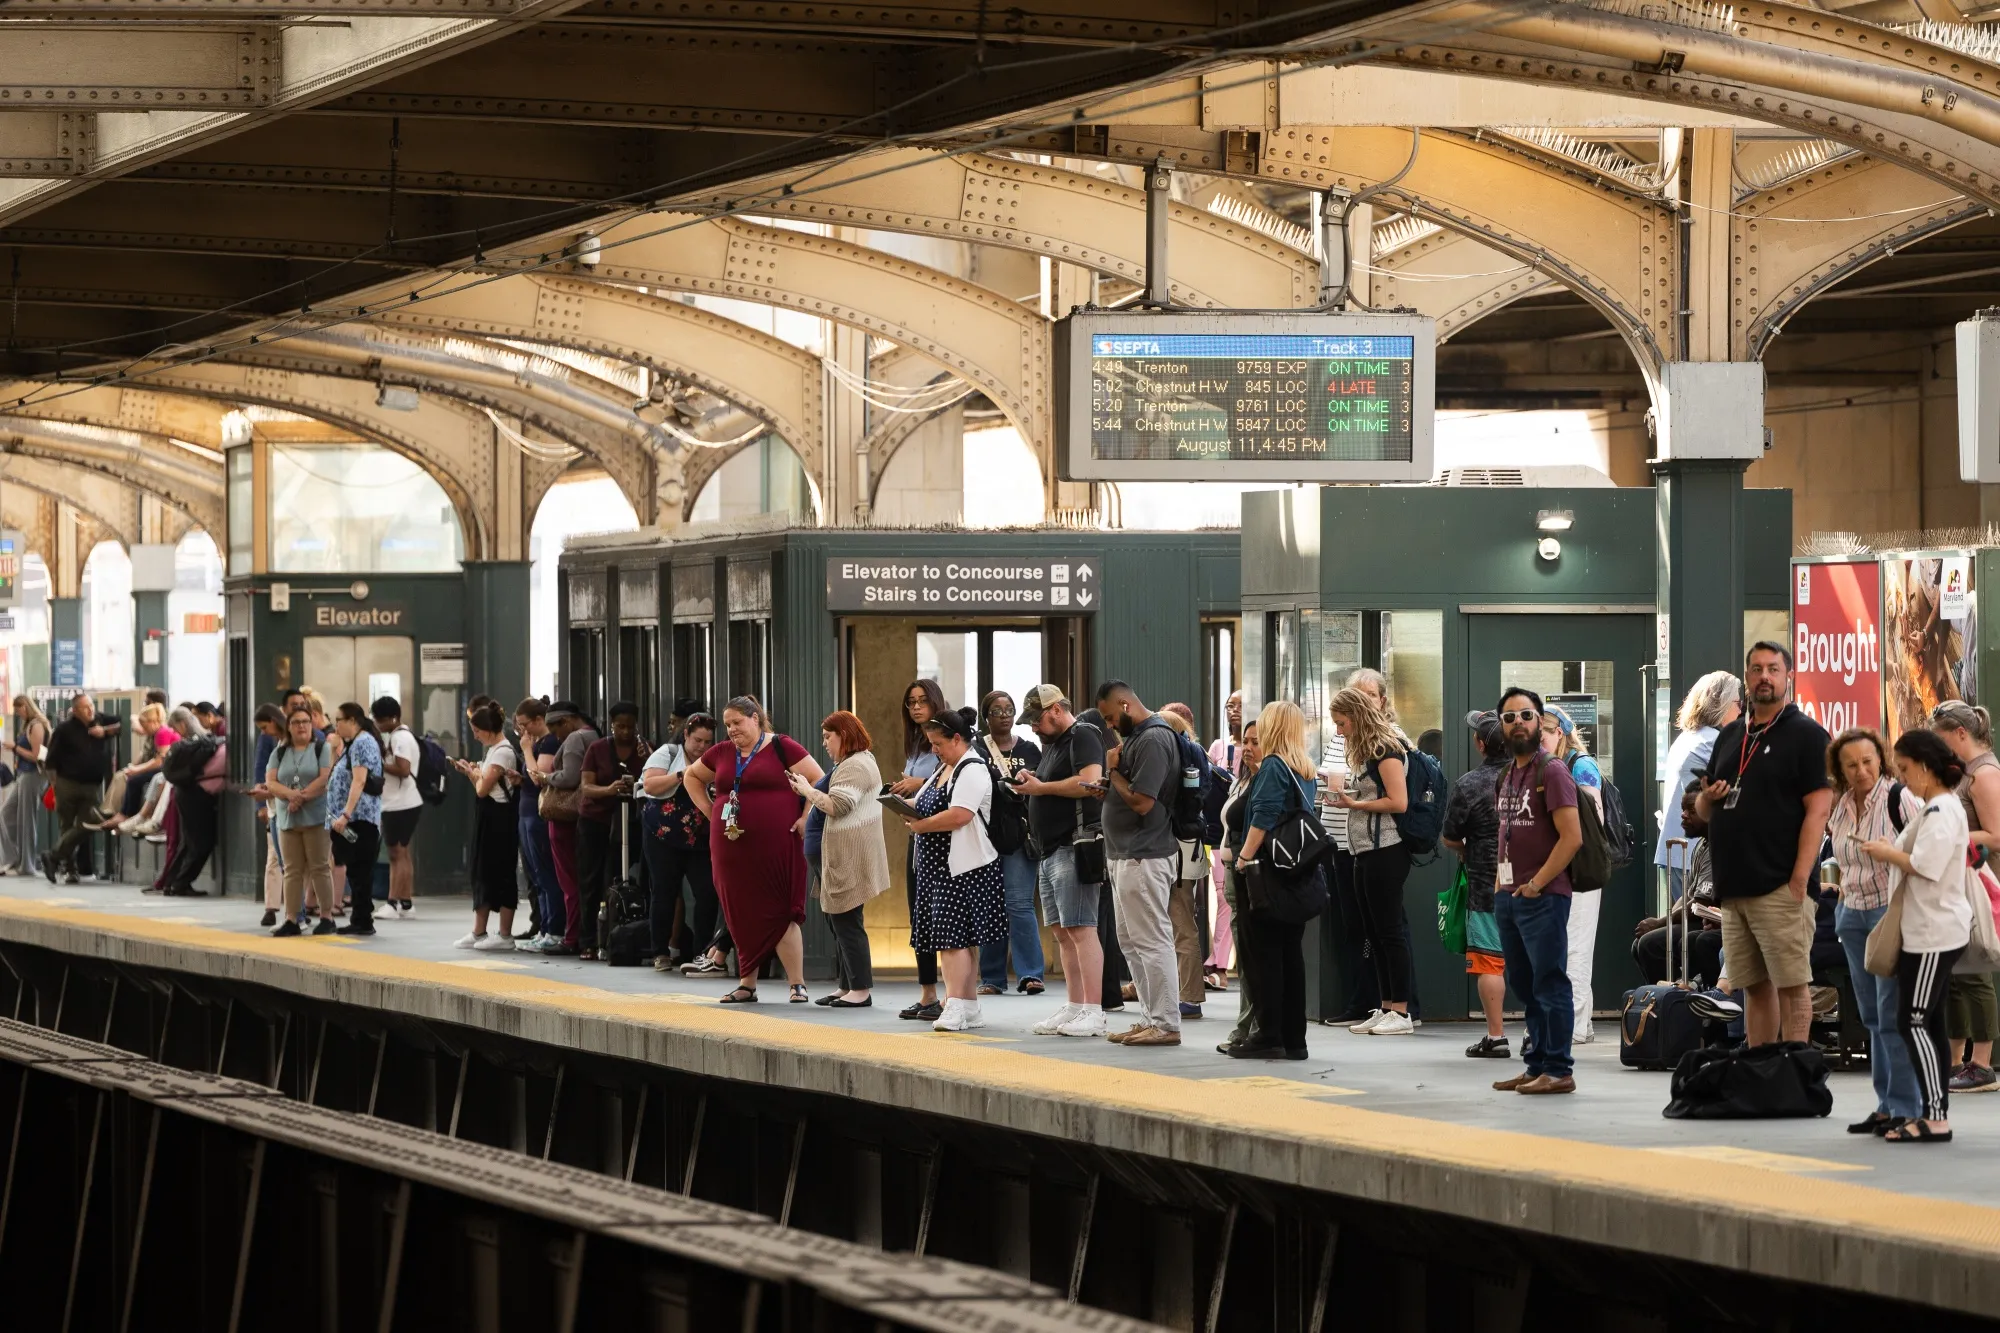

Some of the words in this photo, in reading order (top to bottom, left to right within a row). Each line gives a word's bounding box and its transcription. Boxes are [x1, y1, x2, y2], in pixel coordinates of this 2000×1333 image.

[1114, 341, 1160, 354] SEPTA
[1312, 340, 1358, 354] Track
[1363, 340, 1372, 354] 3
[1092, 360, 1123, 373] 4:49
[1135, 360, 1188, 374] Trenton
[1237, 361, 1271, 374] 9759
[1276, 361, 1307, 374] EXP
[1329, 361, 1350, 375] ON
[1354, 361, 1390, 375] TIME
[1402, 362, 1410, 374] 3
[1093, 379, 1123, 393] 5:02
[1135, 379, 1196, 393] Chestnut
[1199, 380, 1210, 393] H
[1213, 380, 1229, 393] W
[1245, 380, 1271, 393] 845
[1276, 380, 1307, 393] LOC
[1327, 381, 1336, 393] 4
[1340, 380, 1376, 394] LATE
[1402, 381, 1410, 394] 3
[1093, 398, 1123, 412] 5:20
[1134, 398, 1187, 412] Trenton
[1236, 399, 1269, 412] 9761
[1276, 399, 1307, 412] LOC
[1328, 399, 1350, 413] ON
[1354, 400, 1390, 413] TIME
[1401, 400, 1410, 413] 3
[1092, 418, 1122, 431] 5:44
[1135, 418, 1196, 431] Chestnut
[1199, 418, 1210, 431] H
[1213, 418, 1228, 431] W
[1236, 418, 1270, 431] 5847
[1276, 418, 1307, 431] LOC
[1328, 418, 1350, 432] ON
[1354, 418, 1389, 432] TIME
[1401, 419, 1409, 432] 3
[1176, 437, 1231, 455] August
[1302, 437, 1326, 452] PM
[841, 563, 917, 579] Elevator
[922, 564, 940, 579] to
[946, 563, 1043, 579] Concourse
[864, 585, 917, 602] Stairs
[922, 587, 940, 602] to
[946, 586, 1043, 602] Concourse
[1943, 592, 1963, 604] Maryland
[316, 606, 401, 625] Elevator
[1797, 618, 1878, 687] Brought
[1820, 701, 1858, 738] you
[1508, 818, 1535, 827] edicine
